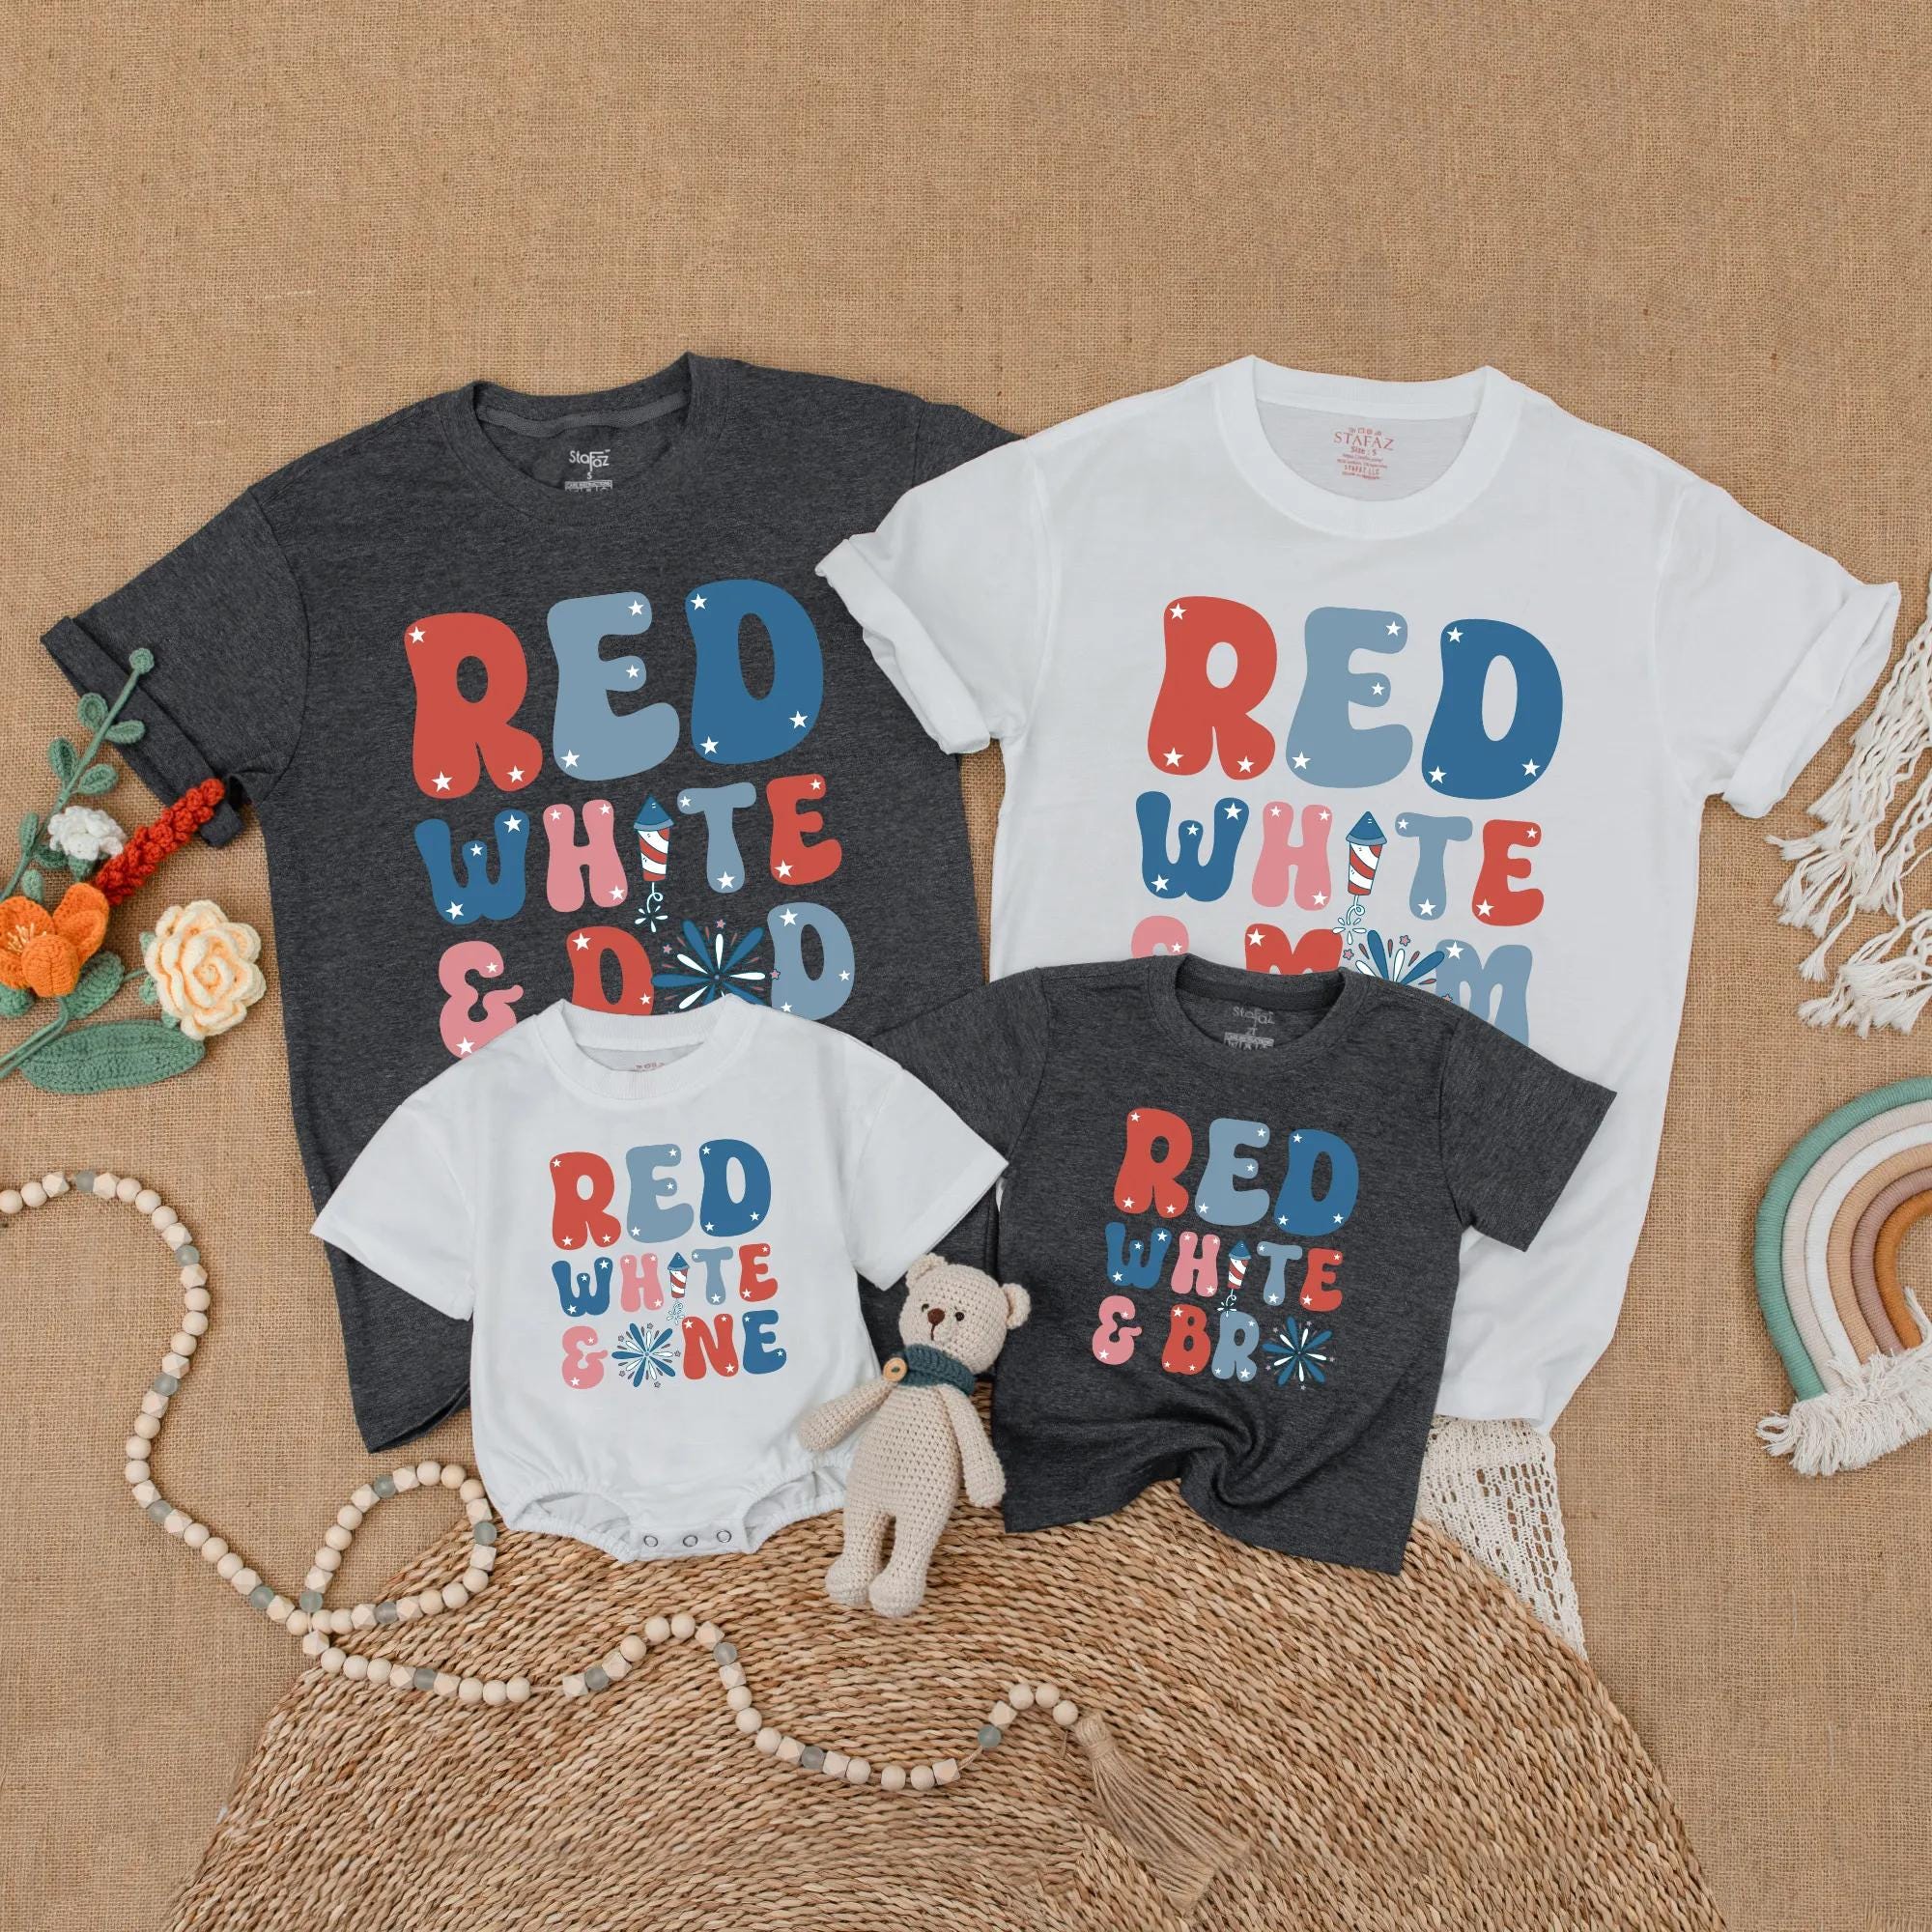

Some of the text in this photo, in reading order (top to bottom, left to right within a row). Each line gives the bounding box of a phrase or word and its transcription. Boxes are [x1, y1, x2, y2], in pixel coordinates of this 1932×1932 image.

[586, 471, 593, 480] S
[1333, 431, 1395, 451] STAFAZ
[404, 579, 824, 799] RED
[1148, 595, 1563, 800] RED
[439, 901, 856, 1060] & DD
[549, 1138, 772, 1250] RED
[1114, 1107, 1359, 1236] RED
[561, 1325, 609, 1389] &
[1092, 1294, 1143, 1365] &
